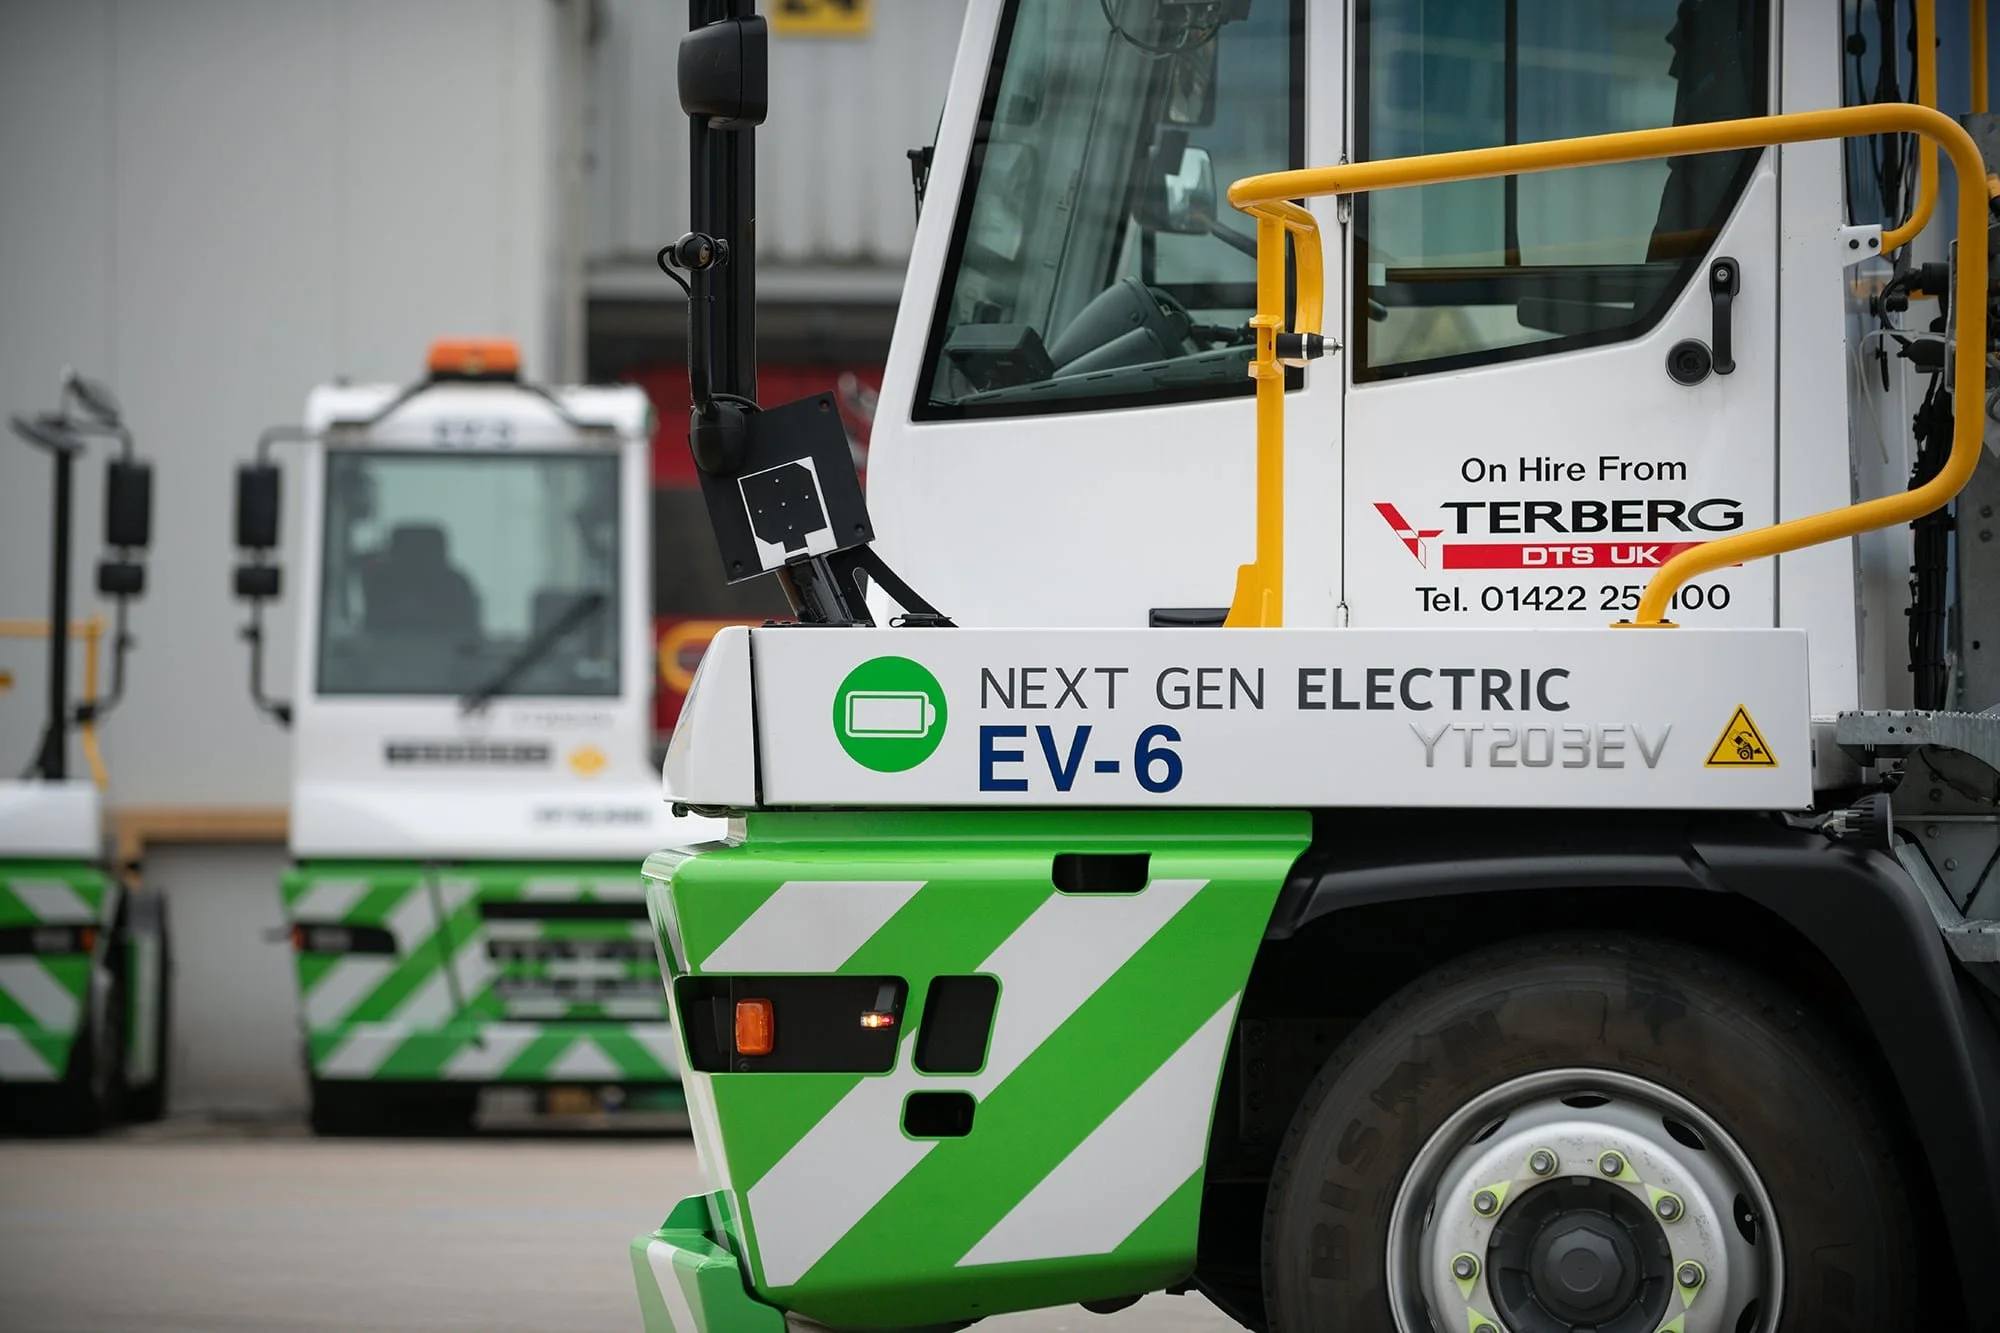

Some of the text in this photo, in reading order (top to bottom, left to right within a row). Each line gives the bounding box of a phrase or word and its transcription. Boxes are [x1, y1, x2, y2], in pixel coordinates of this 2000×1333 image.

[1461, 455, 1687, 483] On Hire From
[1440, 498, 1744, 534] TERBERG
[1522, 545, 1661, 565] DTS UK
[1415, 584, 1731, 612] Tel. 01422 25100
[980, 666, 1571, 711] NEXT GEN ELECTRIC
[979, 724, 1183, 793] EV-6
[1409, 721, 1673, 769] YT203EV
